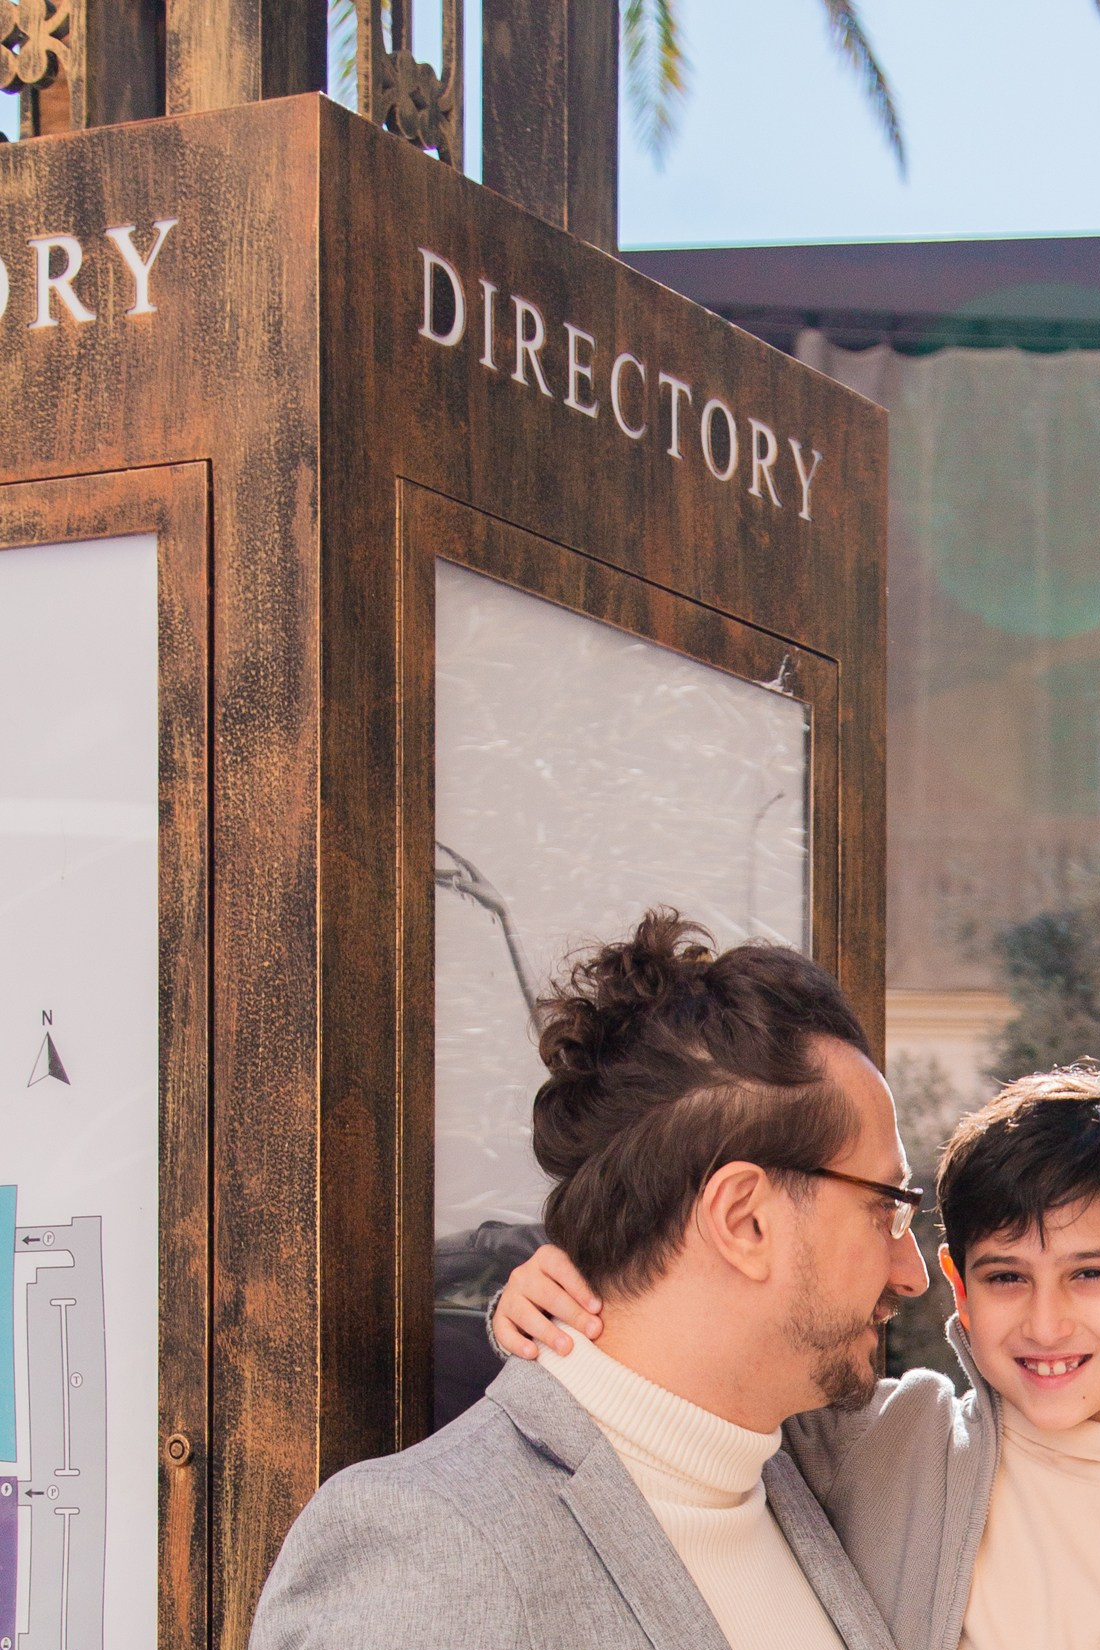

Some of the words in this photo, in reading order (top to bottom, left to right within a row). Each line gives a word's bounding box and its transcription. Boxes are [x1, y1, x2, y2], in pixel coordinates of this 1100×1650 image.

[0, 218, 178, 330] RY
[418, 246, 823, 522] DIRECTORY
[42, 1010, 52, 1026] N
